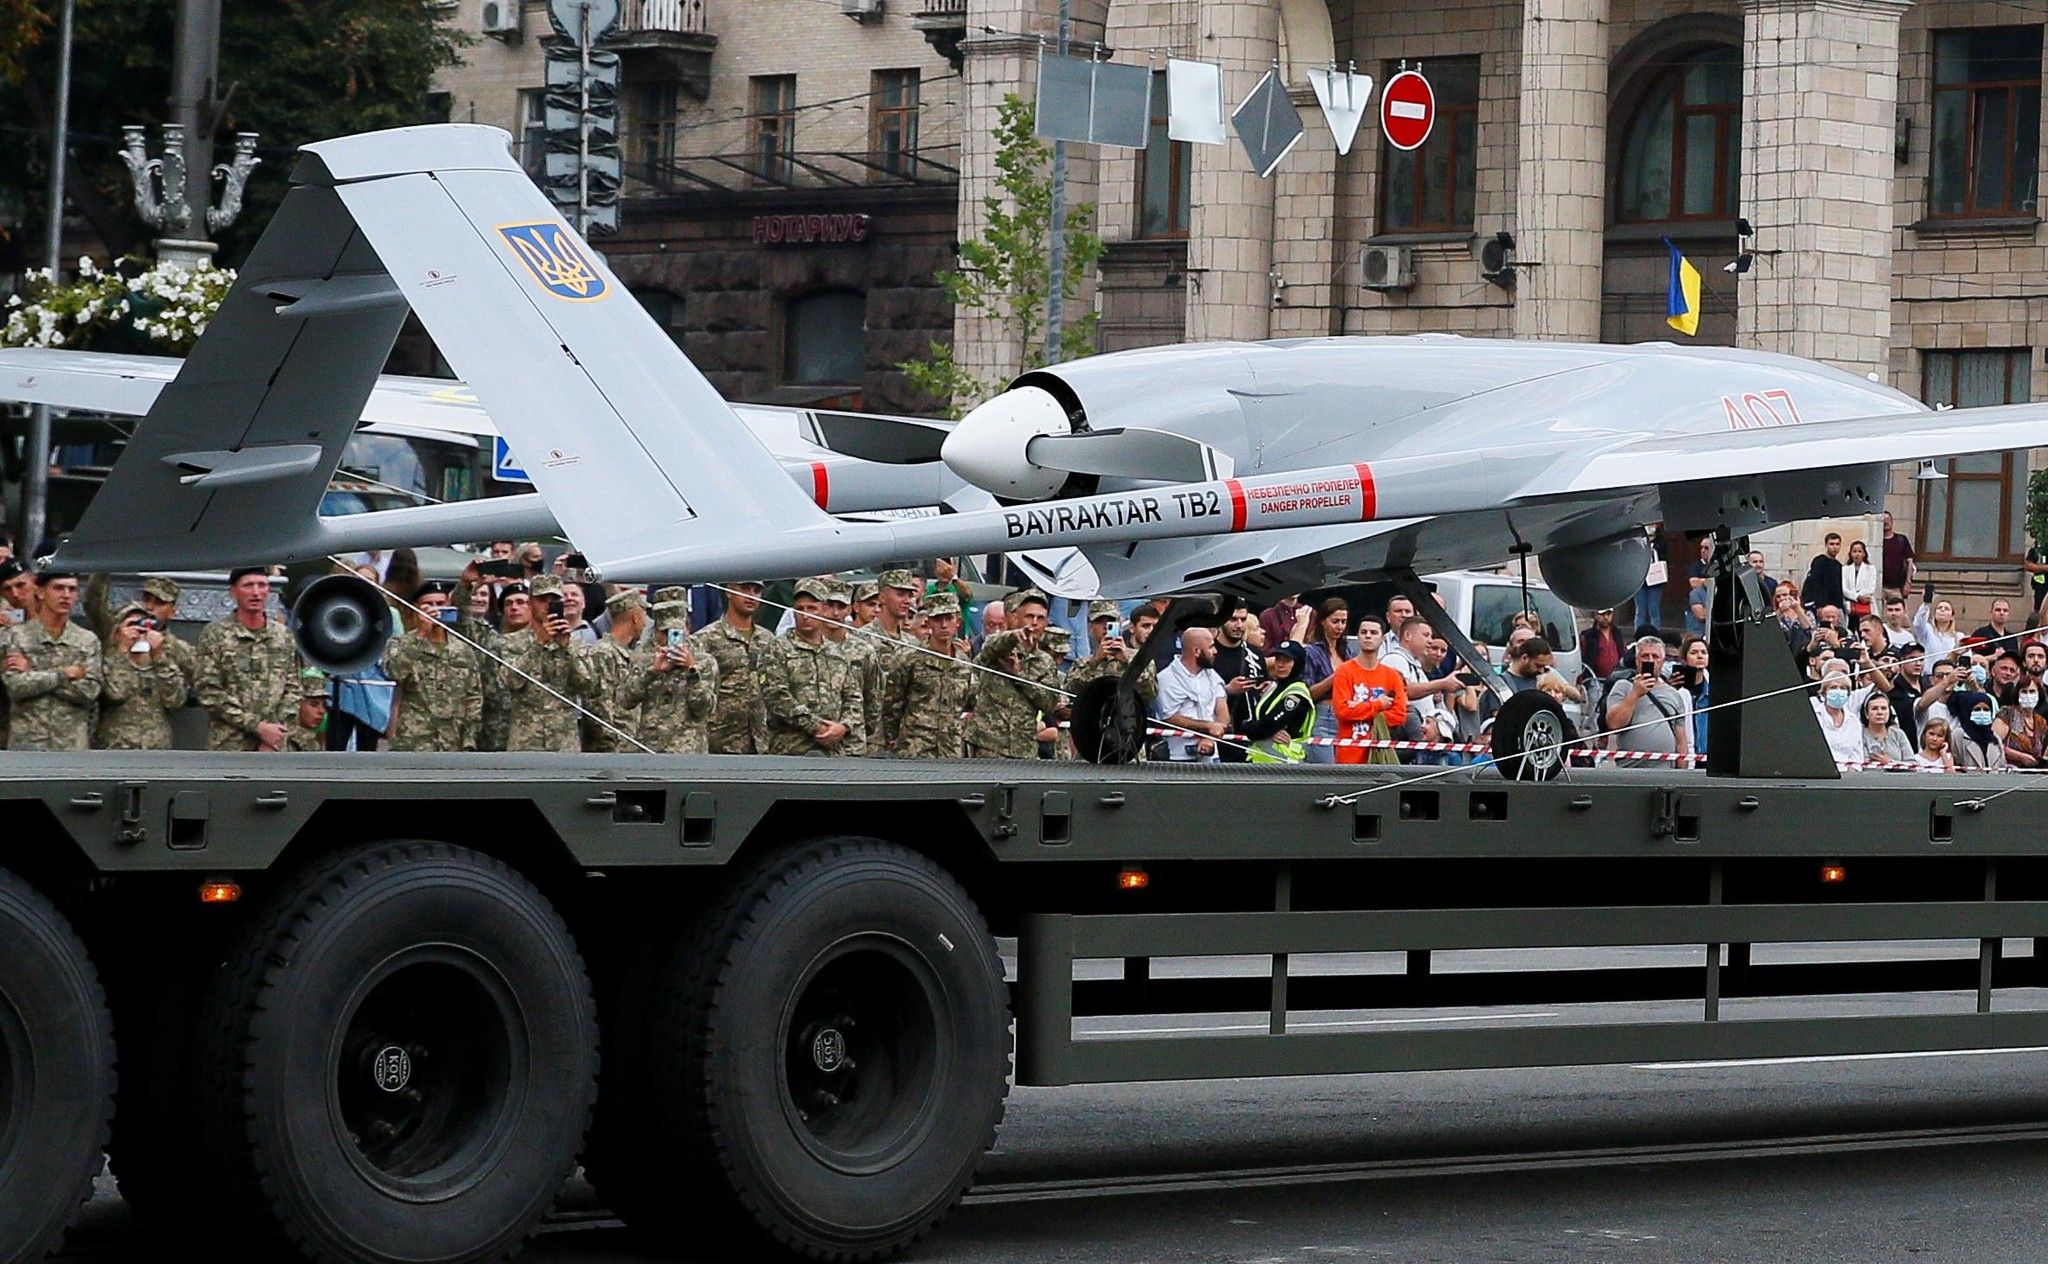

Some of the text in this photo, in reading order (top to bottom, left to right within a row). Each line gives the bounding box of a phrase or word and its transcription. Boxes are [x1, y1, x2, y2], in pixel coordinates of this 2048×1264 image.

[753, 214, 870, 243] НОТАРИУС
[1247, 479, 1360, 500] НЕБЕЗПЕЧНО ПРОПЕЛЕР
[1004, 490, 1222, 538] BAYRAKTAR TB2
[1261, 494, 1351, 514] DANGER PROPELLER
